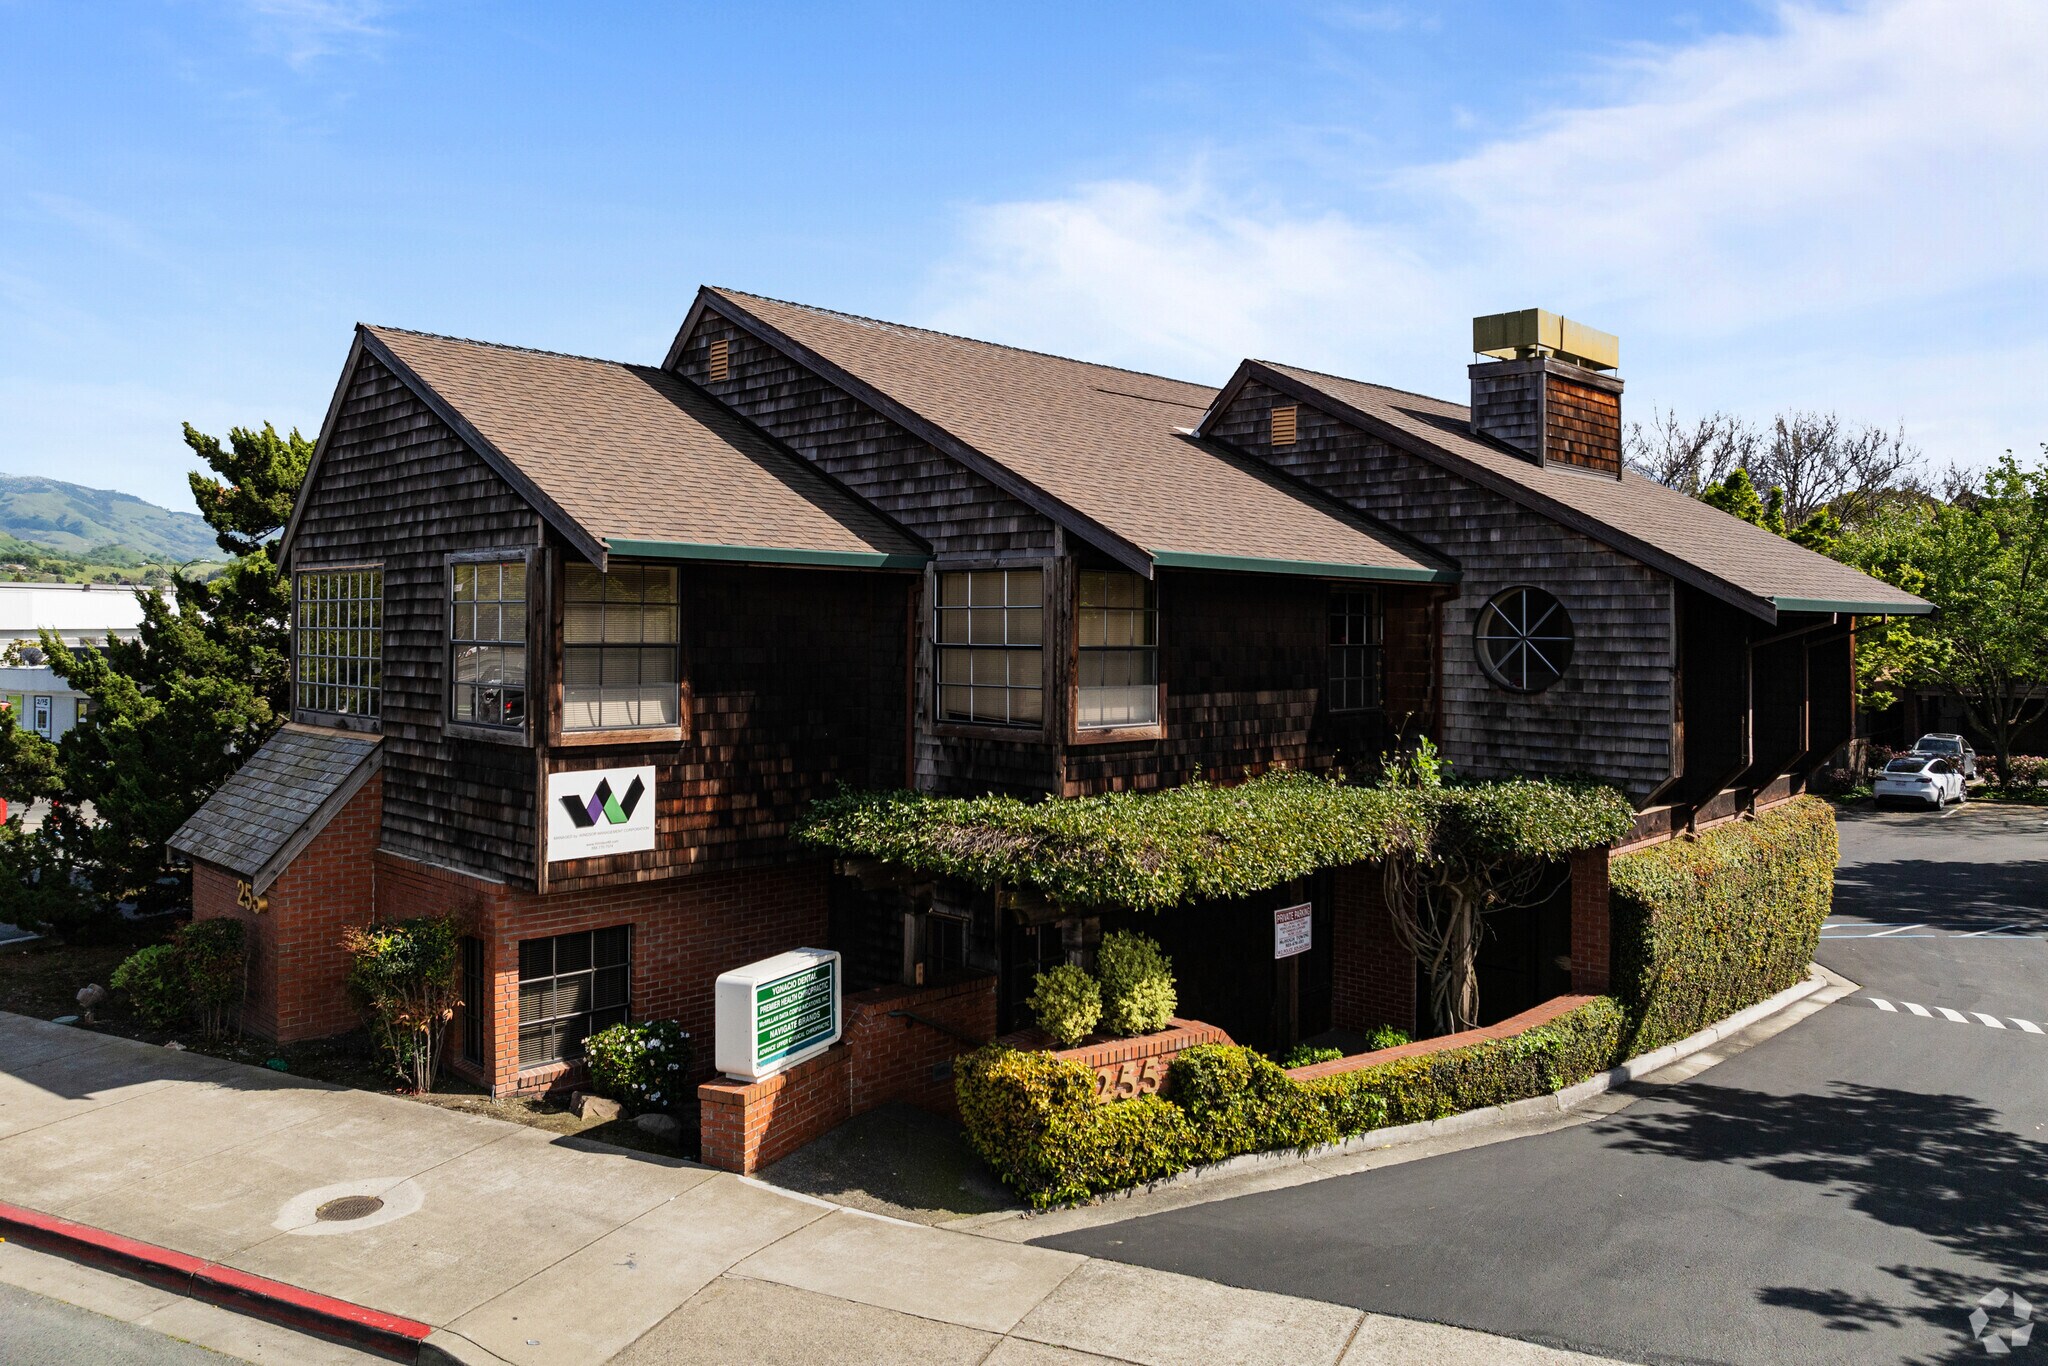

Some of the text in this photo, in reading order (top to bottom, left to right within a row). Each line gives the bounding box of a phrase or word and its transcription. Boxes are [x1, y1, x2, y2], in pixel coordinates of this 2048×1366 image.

[1277, 911, 1294, 924] PRIVATE
[1294, 906, 1310, 919] PARKING
[760, 981, 829, 1014] PREMIER HEALTH CHIROPRACTIC
[772, 972, 817, 995] YGNACIO DENTAL
[759, 1015, 779, 1028] McMILLAN
[779, 1011, 789, 1020] DATA
[769, 1010, 821, 1038] NAVIGATE BRANDS
[758, 1044, 776, 1056] ADVANCE
[777, 1039, 788, 1048] UPPER
[805, 1020, 830, 1035] CHIROPRACTIC
[1096, 1056, 1161, 1105] 255
